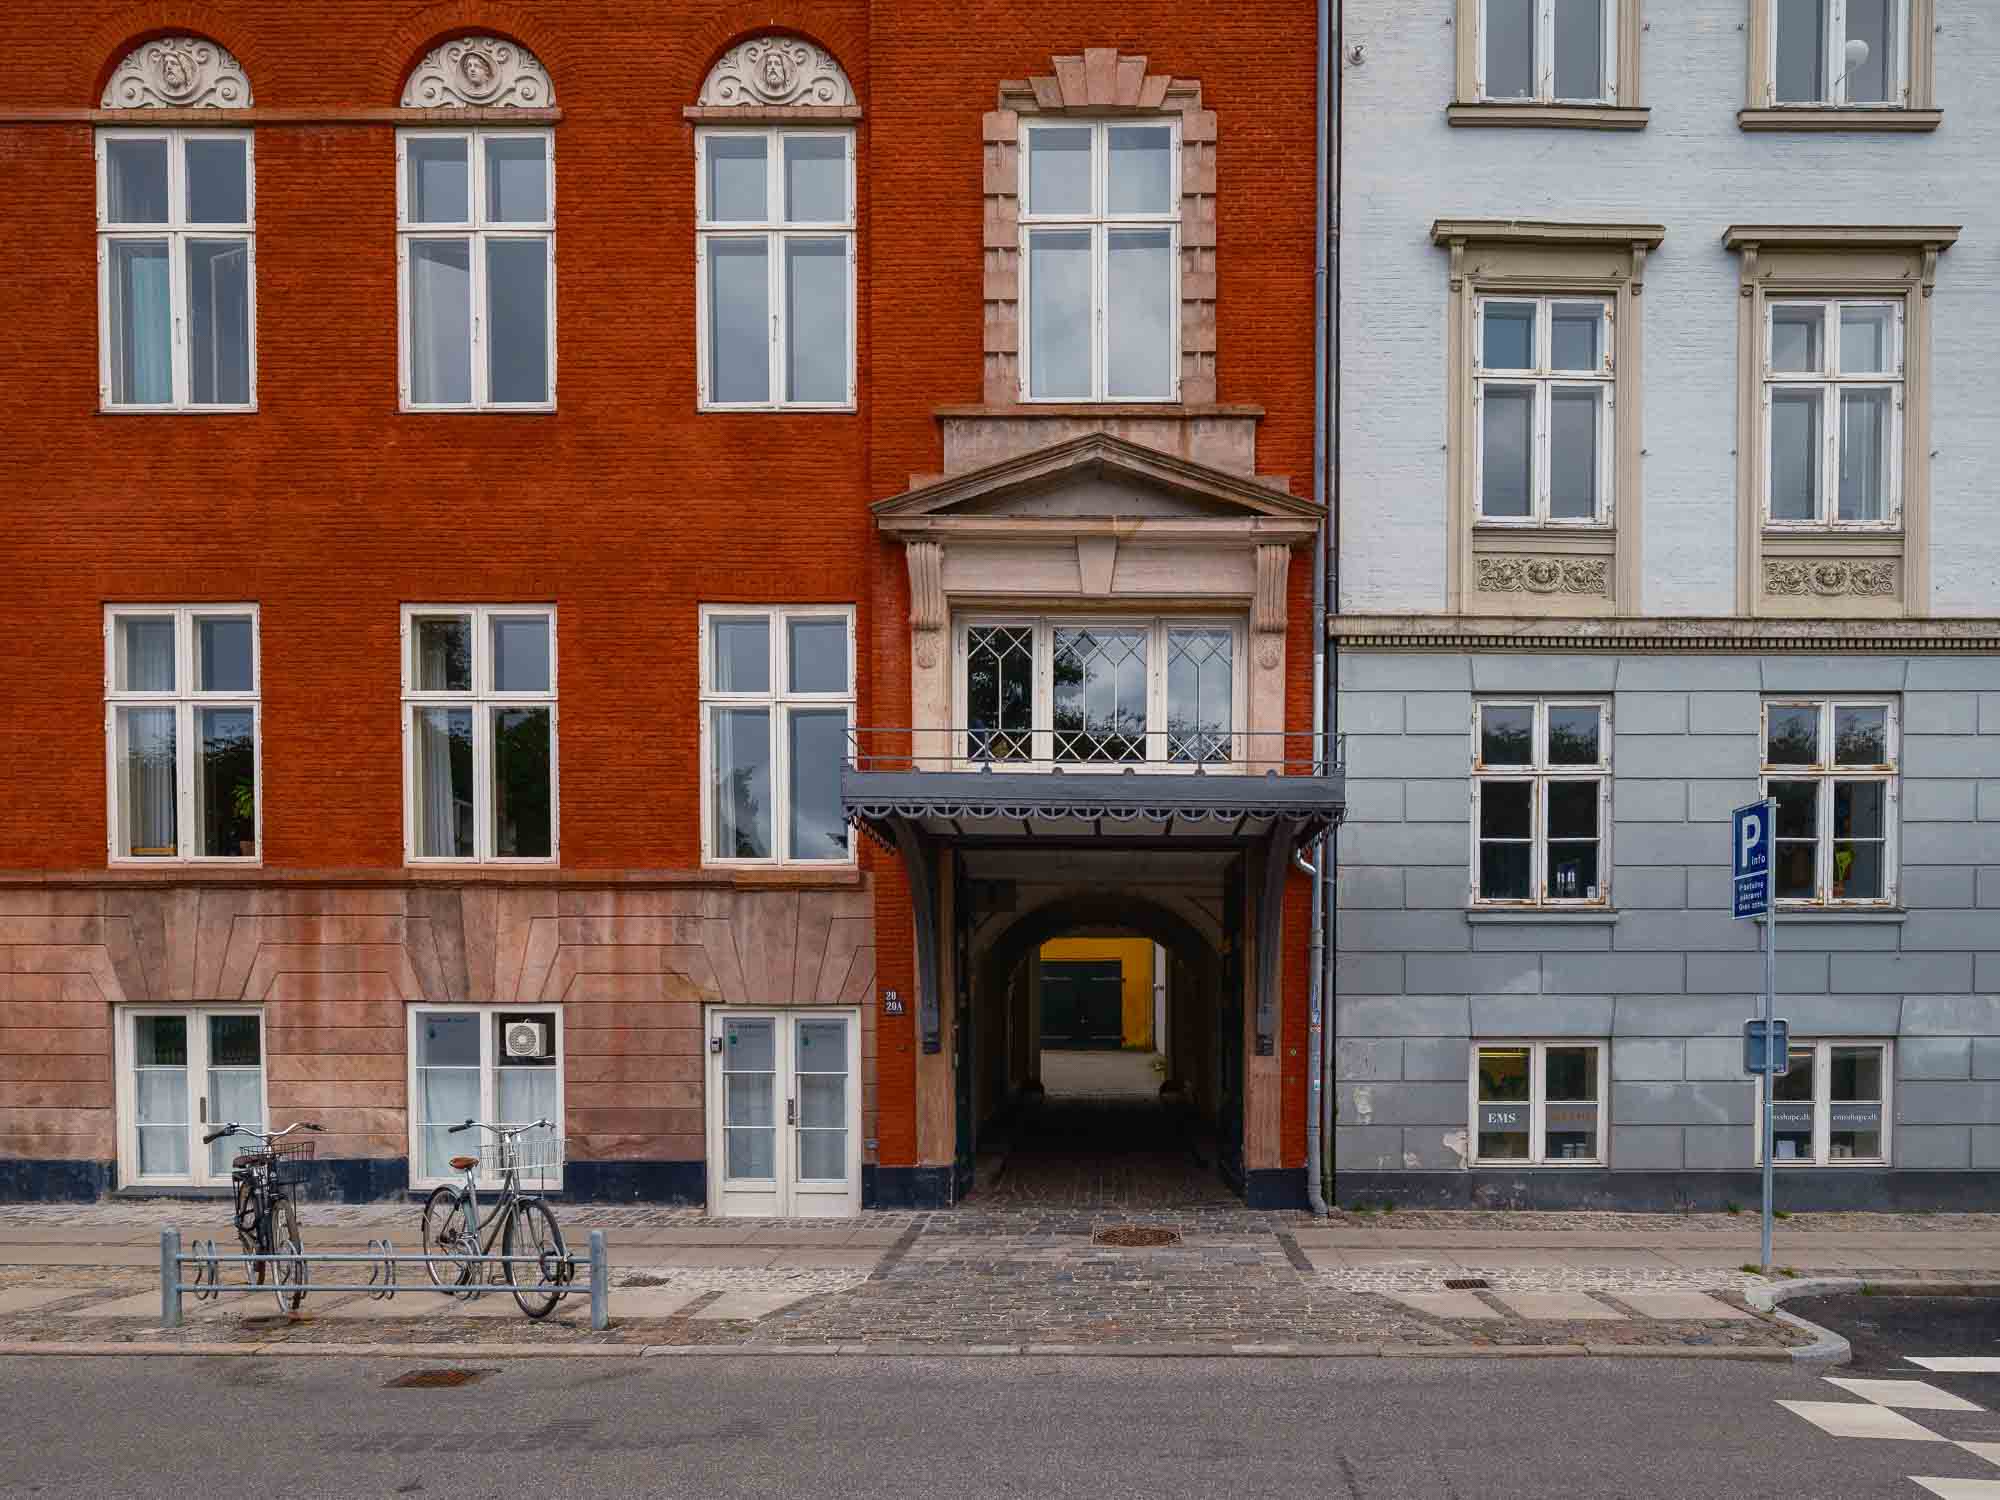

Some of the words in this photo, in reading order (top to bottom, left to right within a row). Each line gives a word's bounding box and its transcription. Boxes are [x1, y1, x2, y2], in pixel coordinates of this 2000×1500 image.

[1742, 815, 1760, 866] P
[1751, 854, 1766, 866] info
[886, 1001, 902, 1011] 20A
[1488, 1112, 1517, 1124] EMS
